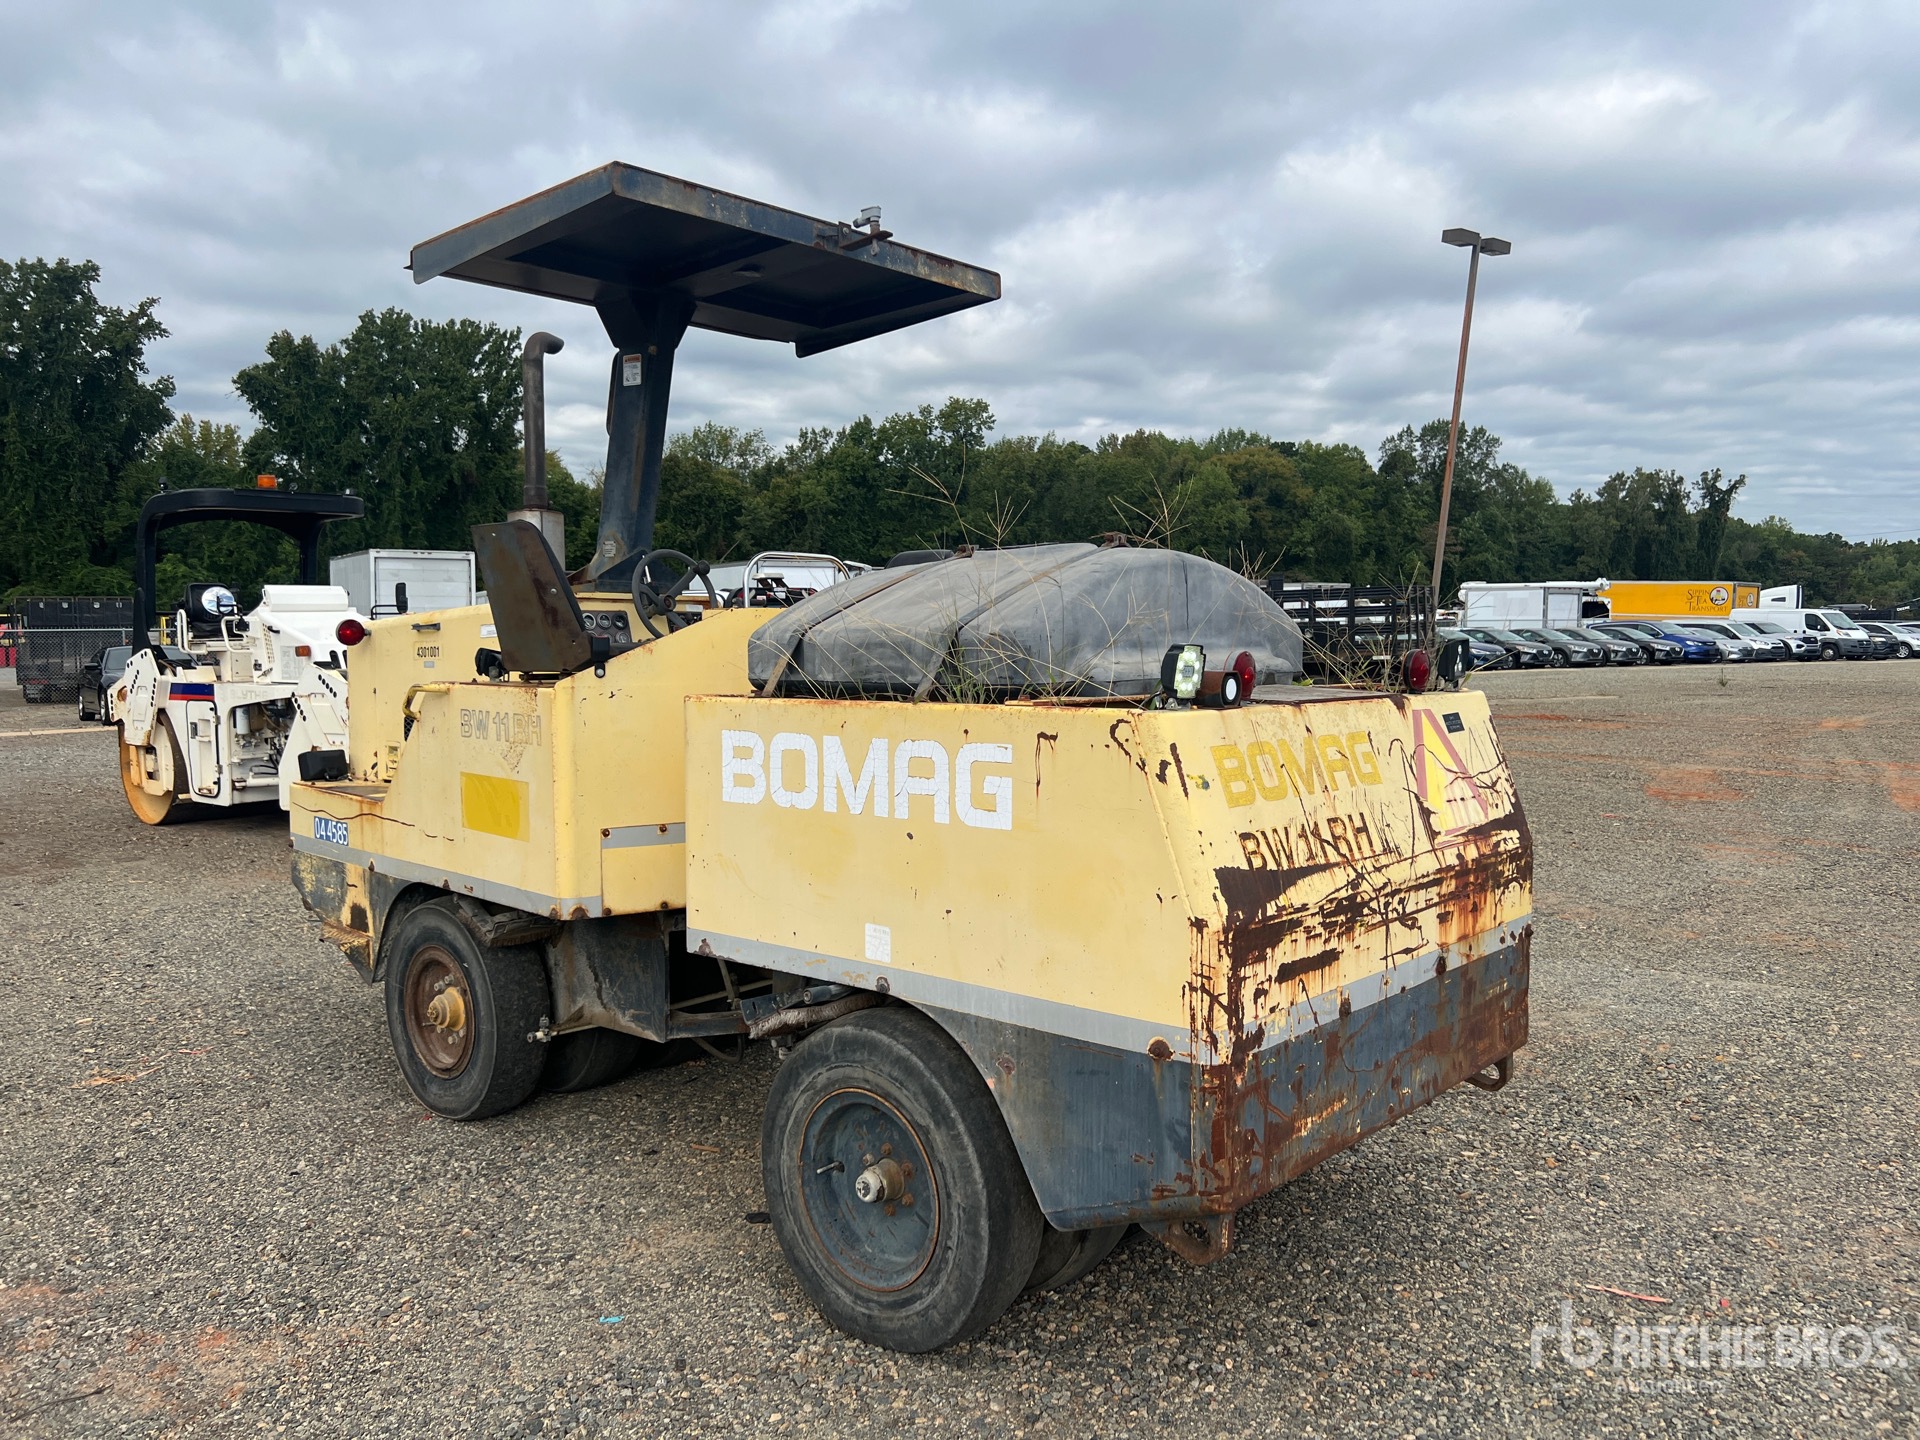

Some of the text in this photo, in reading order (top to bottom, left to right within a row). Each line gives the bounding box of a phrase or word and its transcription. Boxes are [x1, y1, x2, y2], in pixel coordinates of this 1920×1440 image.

[1685, 601, 1728, 612] TRANSPORT
[416, 646, 440, 658] 4301001
[722, 729, 1013, 831] BOMAG
[1210, 731, 1383, 808] BOMAG
